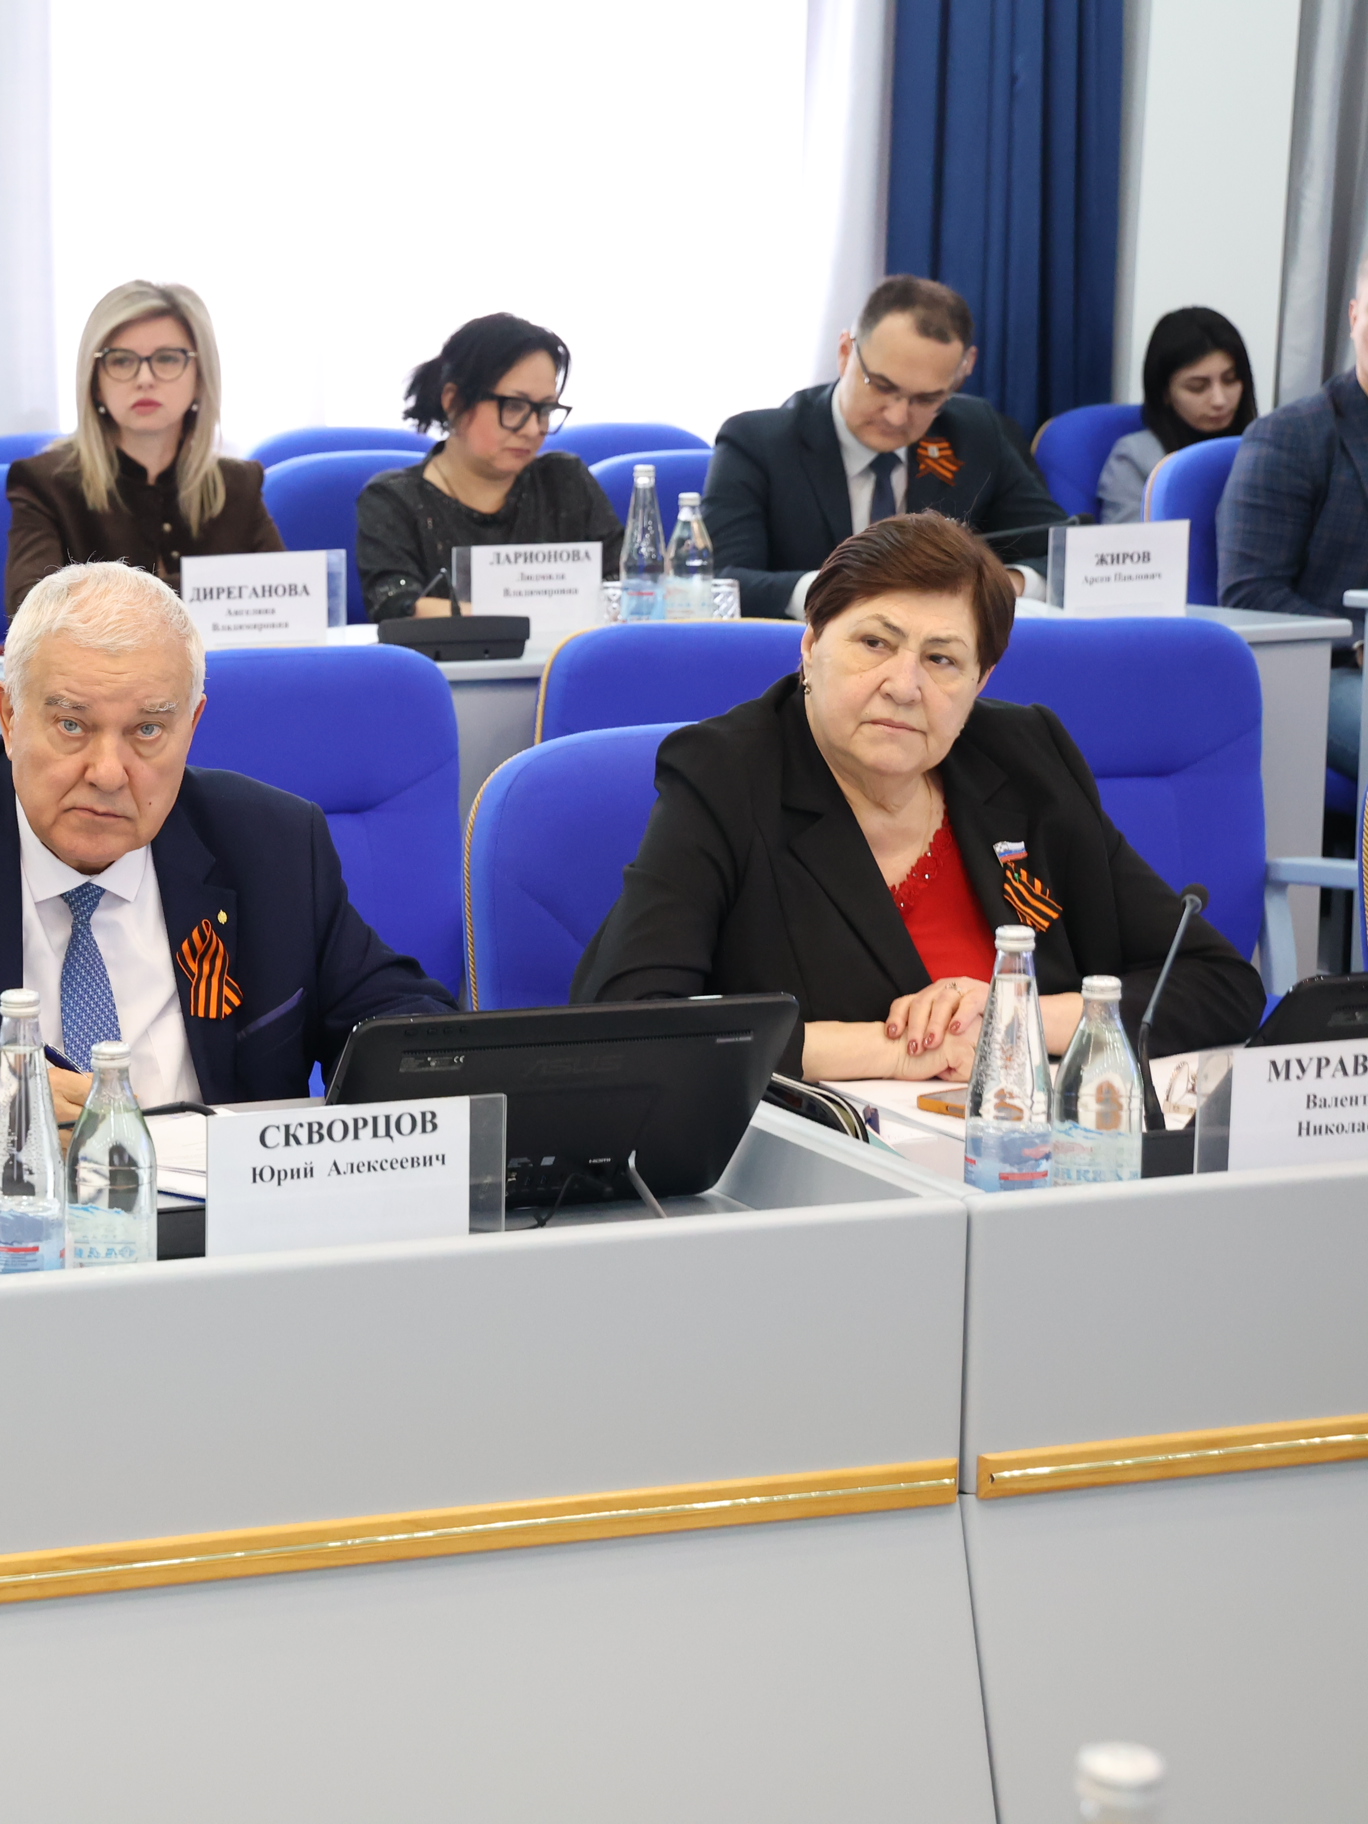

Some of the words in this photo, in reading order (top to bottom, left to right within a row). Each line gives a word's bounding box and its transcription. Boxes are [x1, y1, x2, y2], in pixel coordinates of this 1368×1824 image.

[489, 549, 591, 565] ЛАРИОНОВА
[1094, 550, 1151, 567] ЖИРОВ
[189, 584, 311, 602] ДИРЕГАНОВА
[258, 1110, 439, 1150] СКВОРЦОВ
[1297, 1120, 1368, 1137] Никола
[250, 1161, 315, 1186] Юрий
[327, 1153, 447, 1177] Алексеевич
